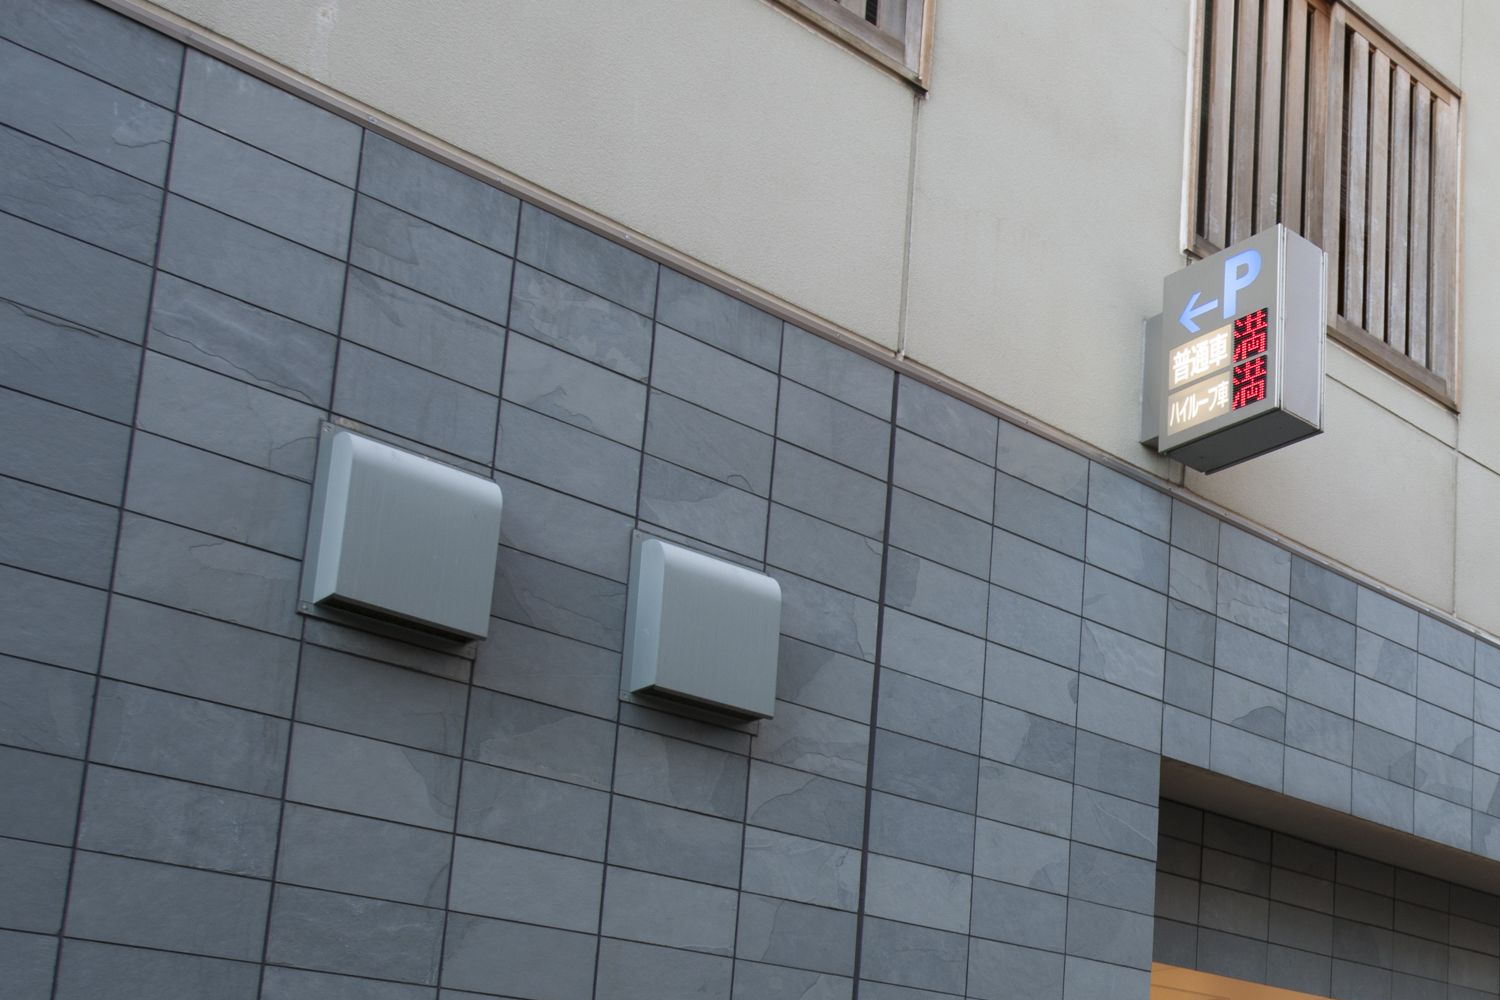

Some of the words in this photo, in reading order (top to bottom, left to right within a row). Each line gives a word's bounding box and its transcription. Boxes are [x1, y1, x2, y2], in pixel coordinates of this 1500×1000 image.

[1223, 249, 1262, 320] P
[1172, 332, 1229, 382] 普通車
[1232, 308, 1268, 363] 満
[1170, 382, 1229, 427] ハイルーフ車
[1232, 357, 1267, 411] 満
